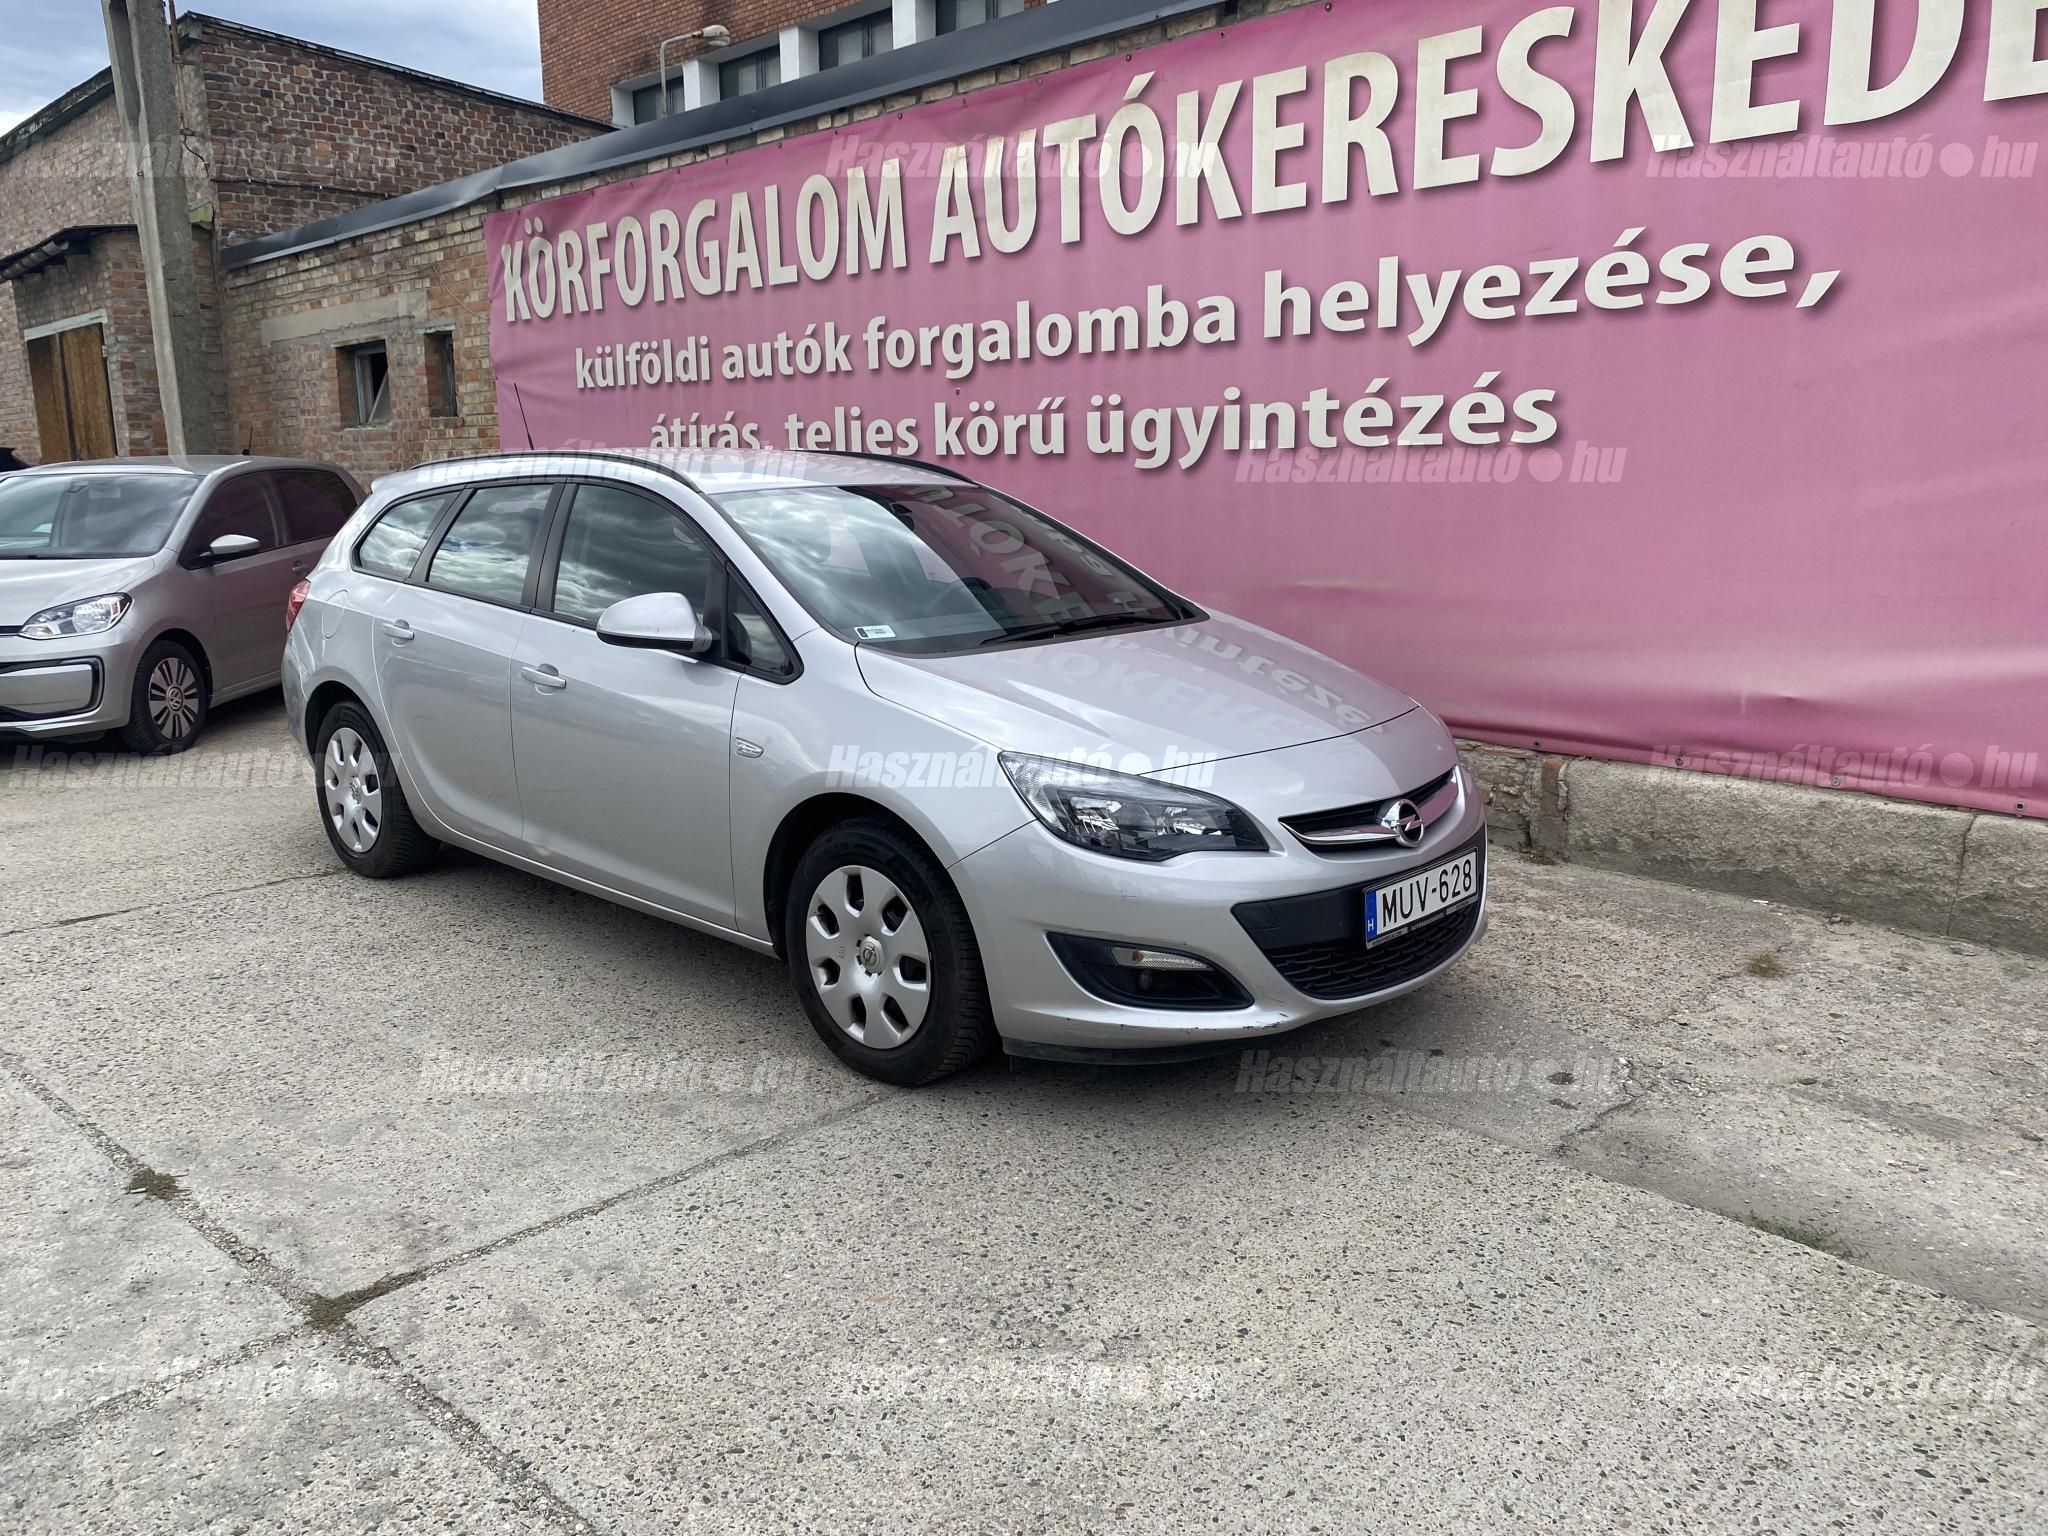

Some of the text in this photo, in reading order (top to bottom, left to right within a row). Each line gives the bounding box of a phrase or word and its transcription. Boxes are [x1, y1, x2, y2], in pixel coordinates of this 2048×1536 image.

[502, 158, 907, 323] KÖRFORGALOM
[575, 226, 1841, 389] külföldi autók forgalomba helyezése,
[934, 396, 1066, 455] körű
[1086, 371, 1559, 470] ügyintézés
[1367, 918, 1375, 932] H
[1382, 859, 1472, 928] MUV-628
